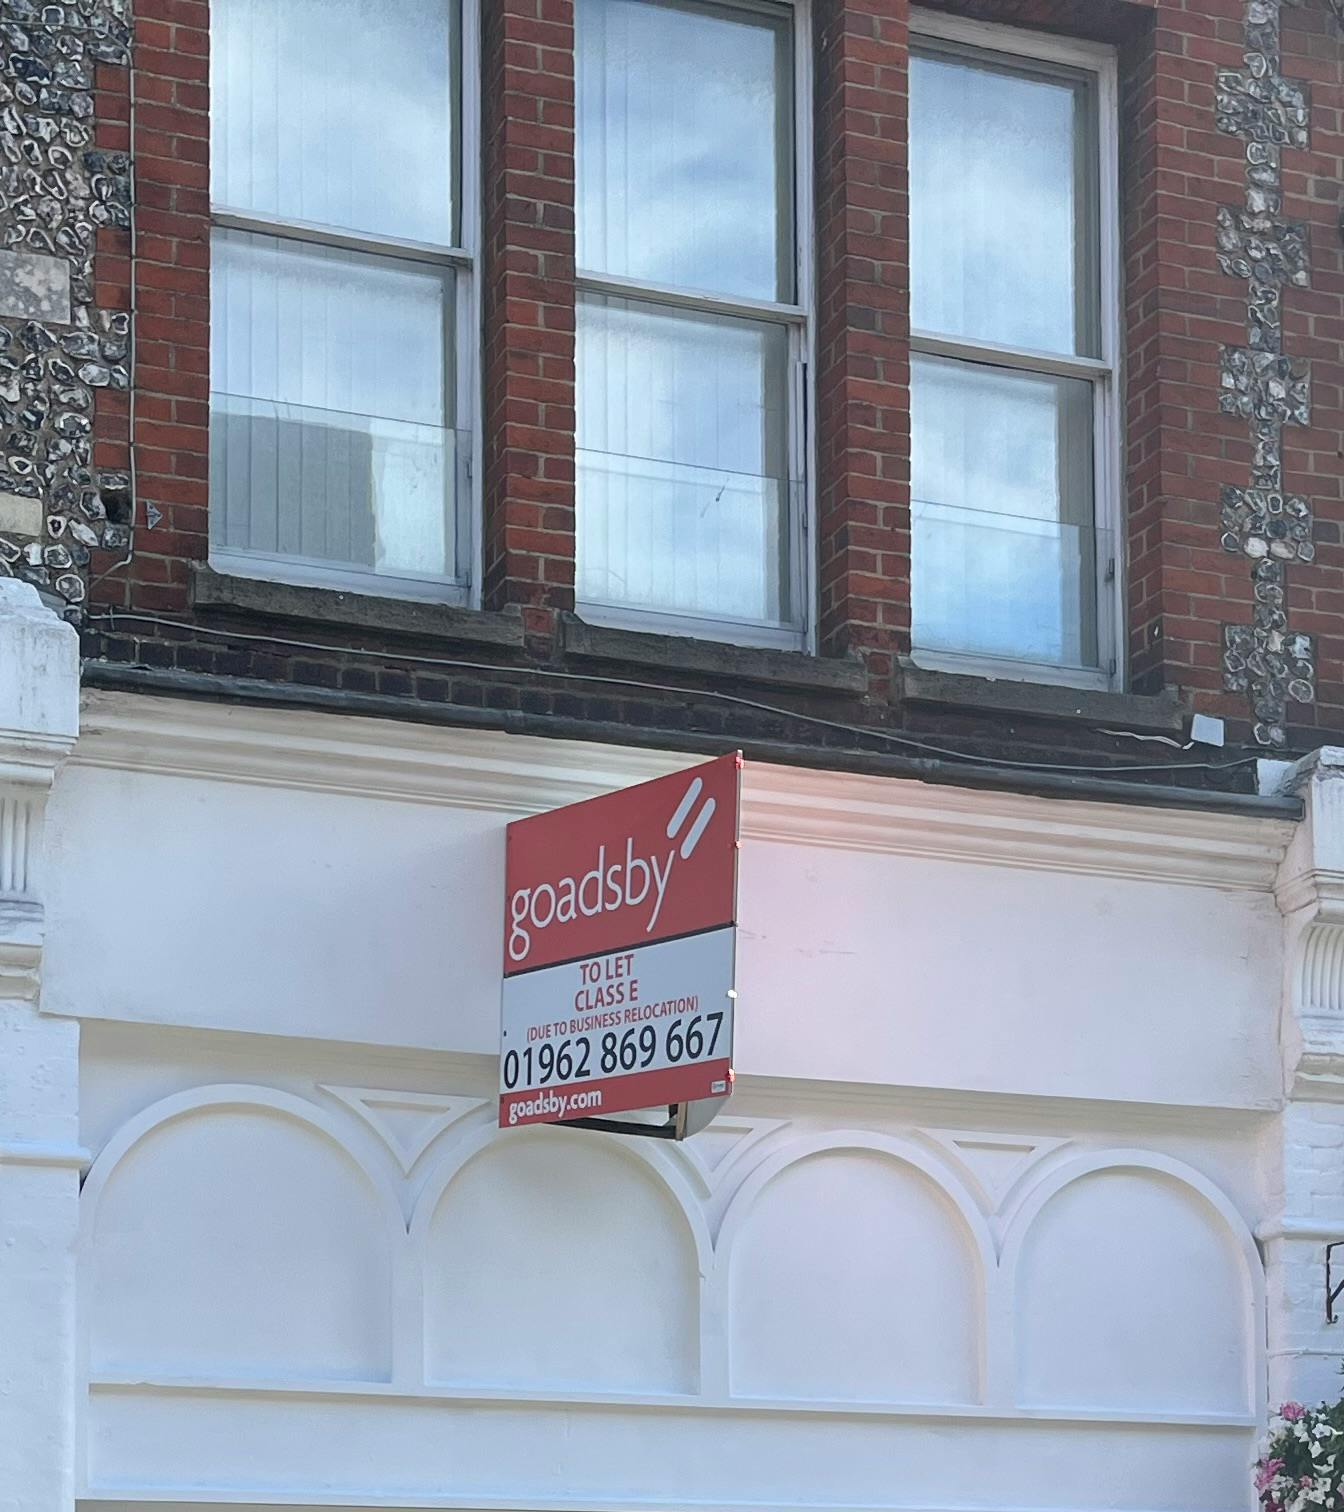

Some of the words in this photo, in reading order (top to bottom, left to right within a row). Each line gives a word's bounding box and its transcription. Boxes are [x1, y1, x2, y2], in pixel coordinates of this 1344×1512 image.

[509, 838, 675, 961] goadsby
[580, 962, 602, 984] TO
[605, 954, 634, 981] LET
[575, 982, 625, 1012] CLASS
[629, 980, 639, 1001] E
[526, 1024, 552, 1044] (DUE
[552, 1021, 568, 1037] TO
[569, 1011, 622, 1035] BUSINESS
[624, 995, 699, 1026] RELOCATION)
[503, 1038, 592, 1090] 01962
[600, 1025, 657, 1075] 869
[665, 1011, 724, 1063] 667
[508, 1089, 602, 1124] goadsby.com
